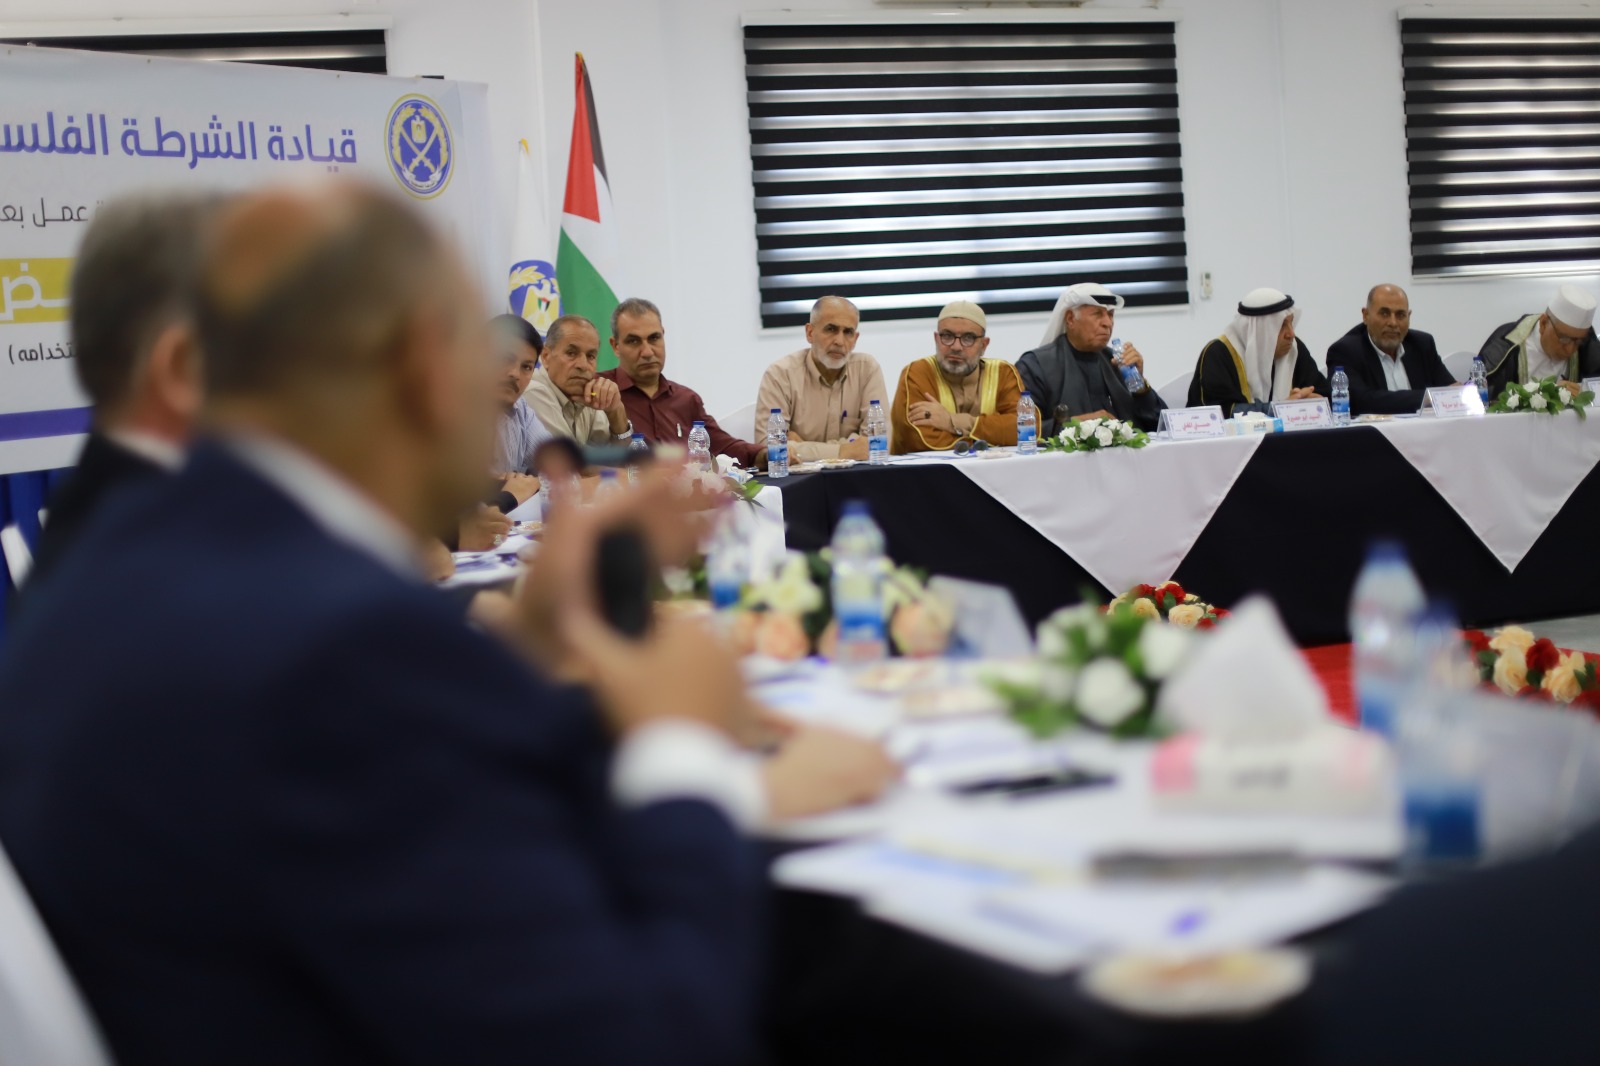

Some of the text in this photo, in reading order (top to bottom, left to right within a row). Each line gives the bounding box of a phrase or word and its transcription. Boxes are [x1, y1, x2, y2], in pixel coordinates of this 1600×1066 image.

[120, 114, 257, 169] الشرطة
[266, 126, 357, 173] قيادة
[33, 197, 88, 227] عمل
